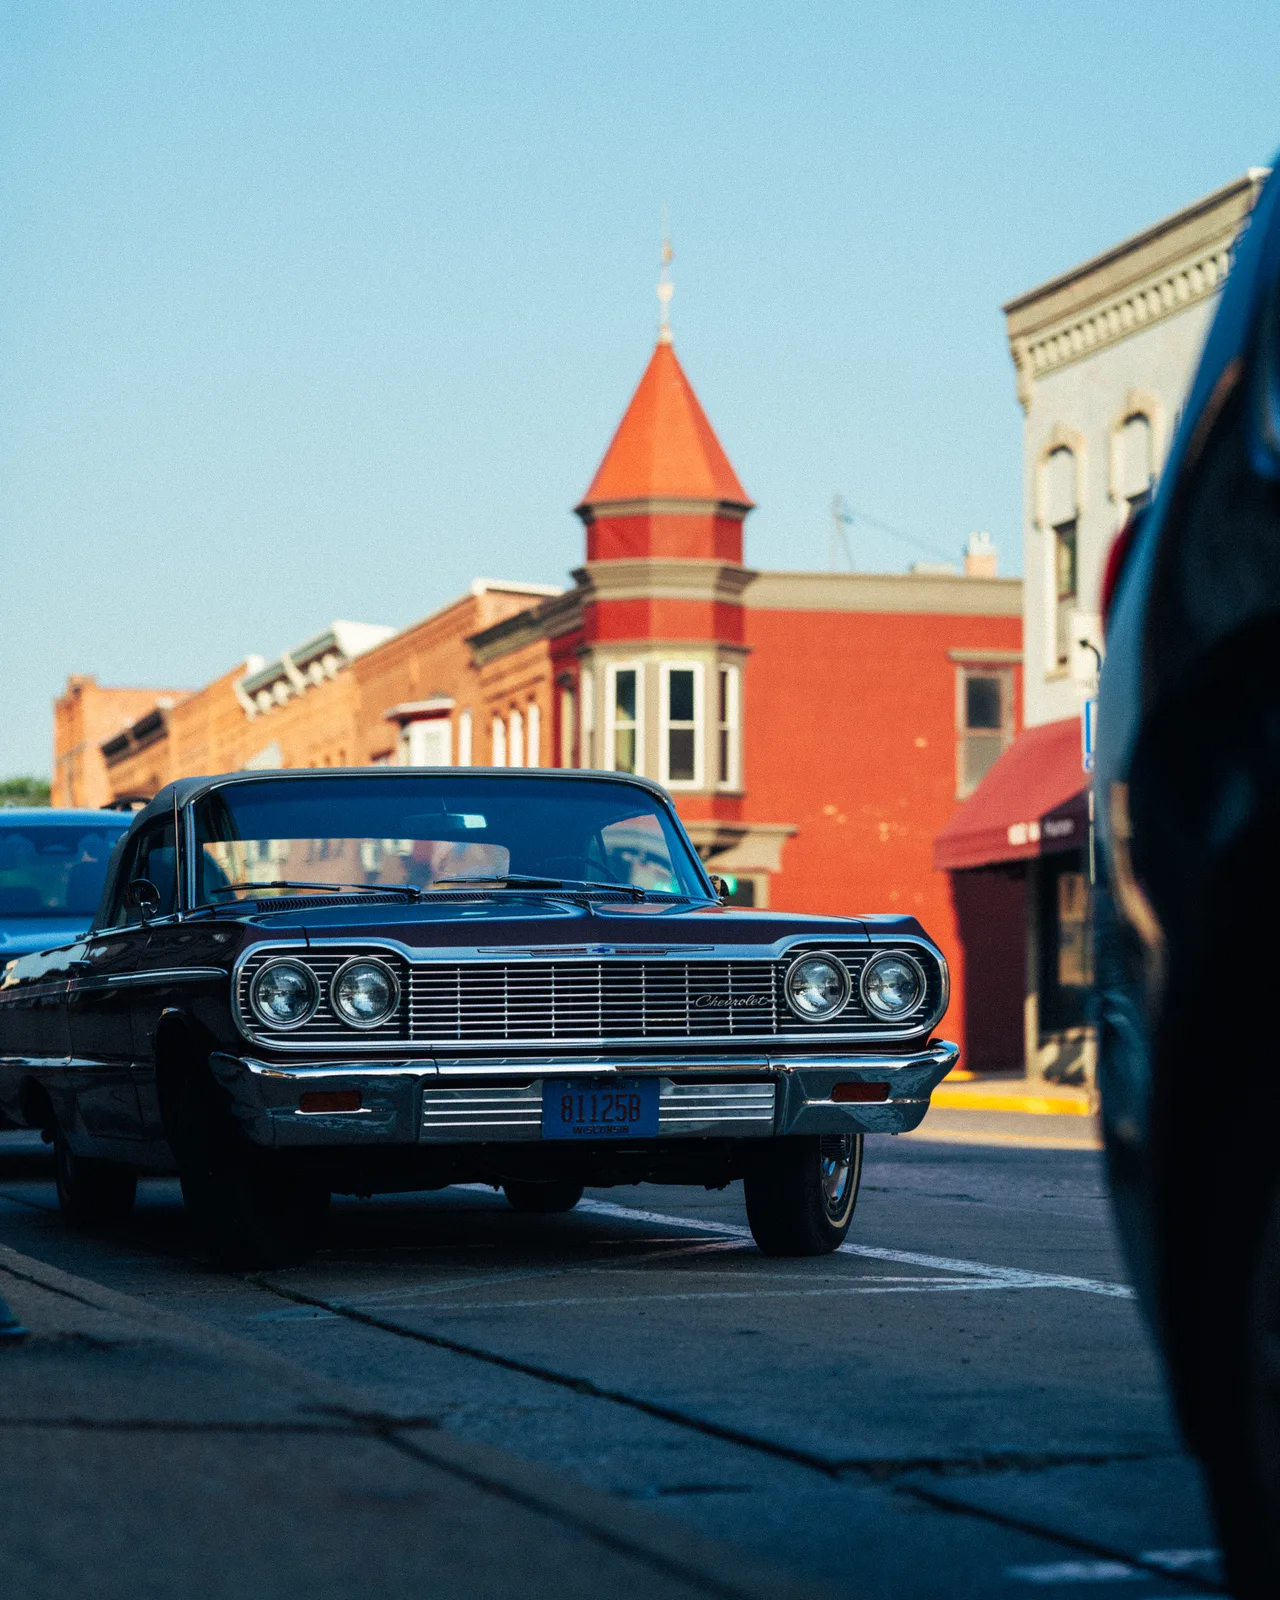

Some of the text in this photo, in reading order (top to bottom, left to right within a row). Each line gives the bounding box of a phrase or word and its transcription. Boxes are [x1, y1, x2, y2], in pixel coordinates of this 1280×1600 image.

[695, 994, 768, 1008] Chevrolet
[561, 1093, 641, 1123] 81125B
[573, 1125, 630, 1135] WISCONSIN
